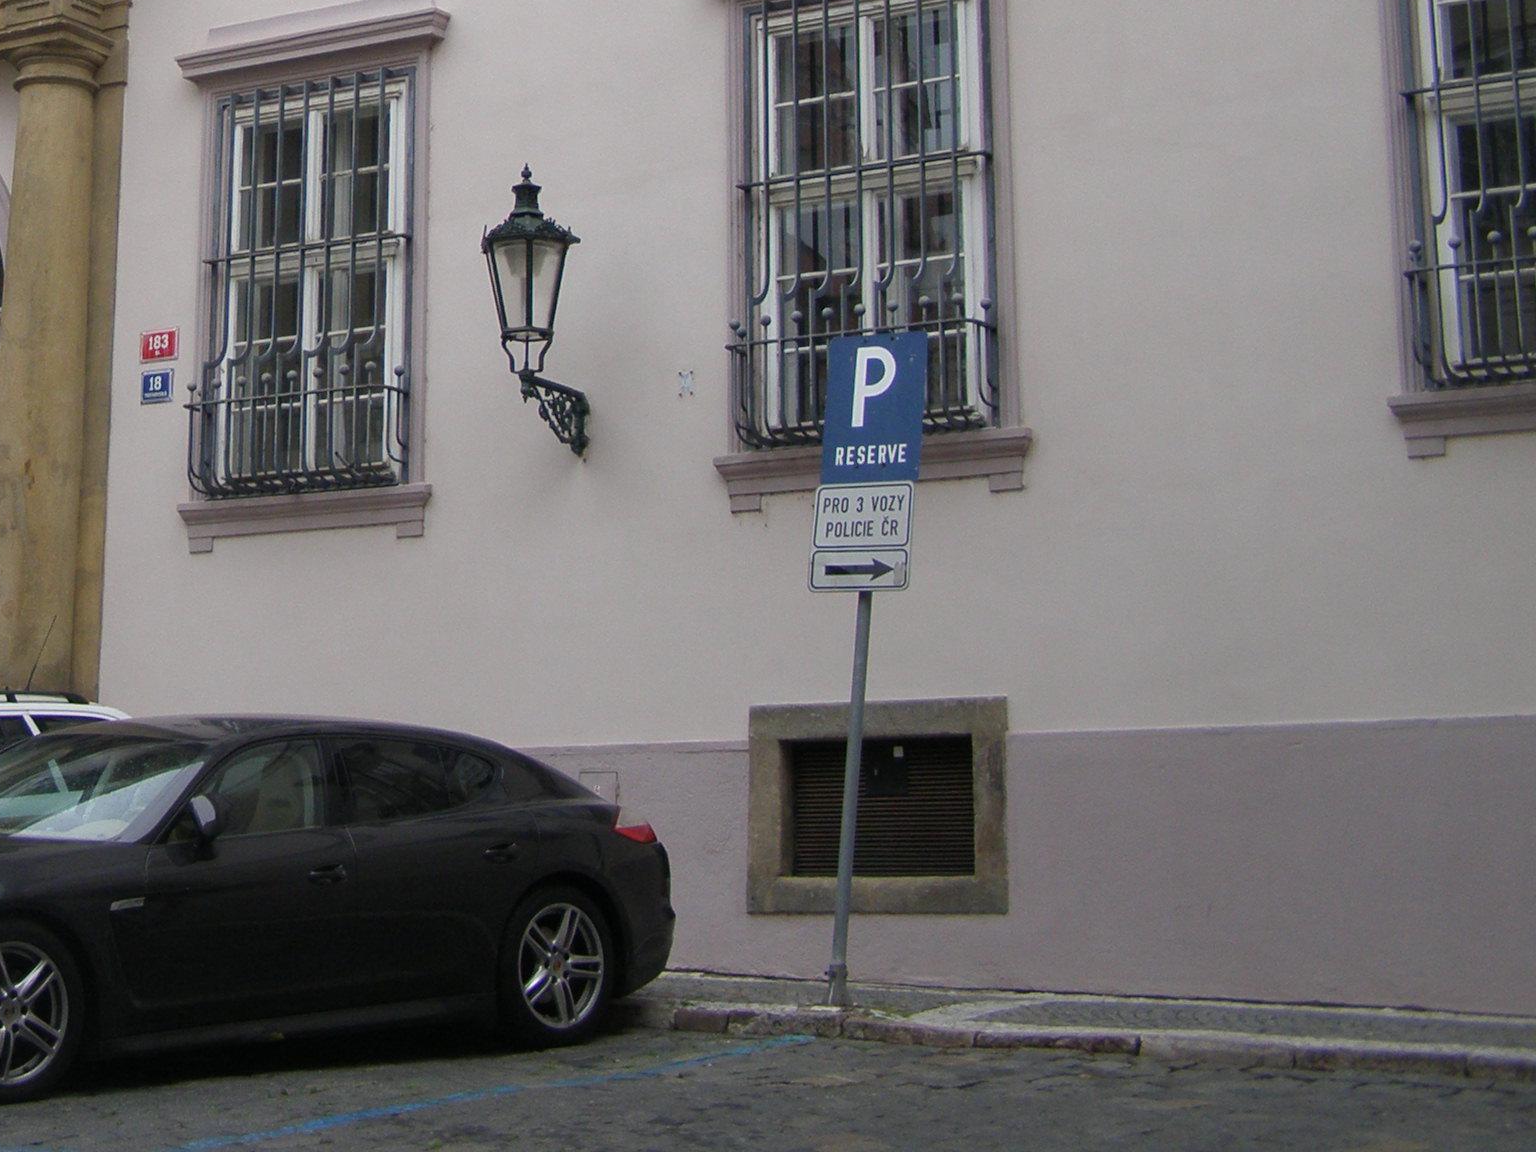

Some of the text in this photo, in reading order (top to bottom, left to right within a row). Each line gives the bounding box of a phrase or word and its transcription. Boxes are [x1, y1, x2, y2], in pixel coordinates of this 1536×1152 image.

[148, 334, 169, 350] 183
[149, 376, 162, 391] 18
[851, 346, 896, 428] P
[835, 443, 907, 466] RESERVE
[822, 494, 905, 514] PRO 3 VOZY
[825, 515, 898, 538] POLICIE ČR
